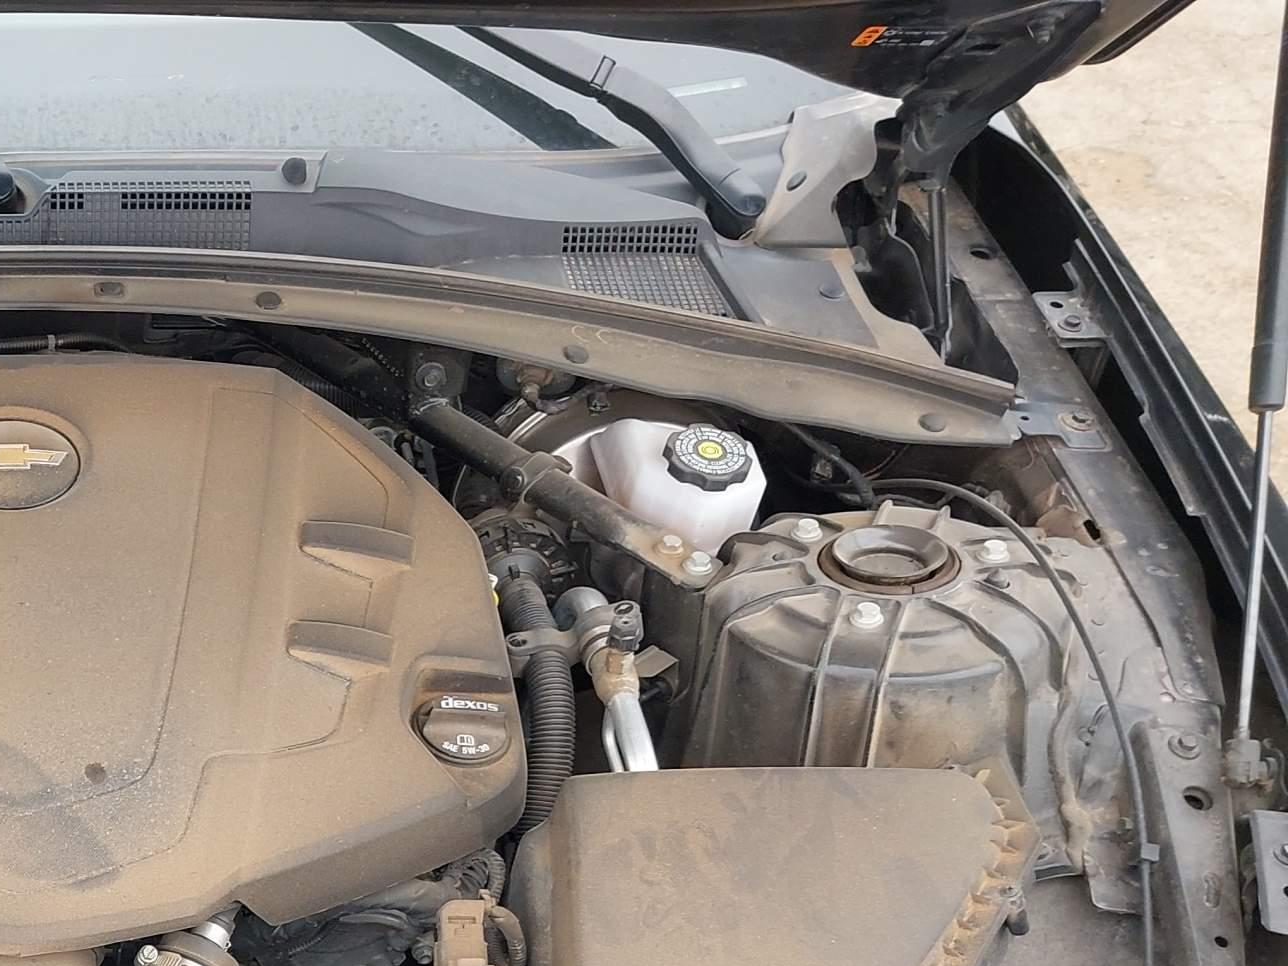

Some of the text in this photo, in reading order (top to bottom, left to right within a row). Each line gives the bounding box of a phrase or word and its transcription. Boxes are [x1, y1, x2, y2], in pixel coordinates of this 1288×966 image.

[440, 696, 499, 712] dexos
[442, 741, 490, 754] SAE 5W-30
